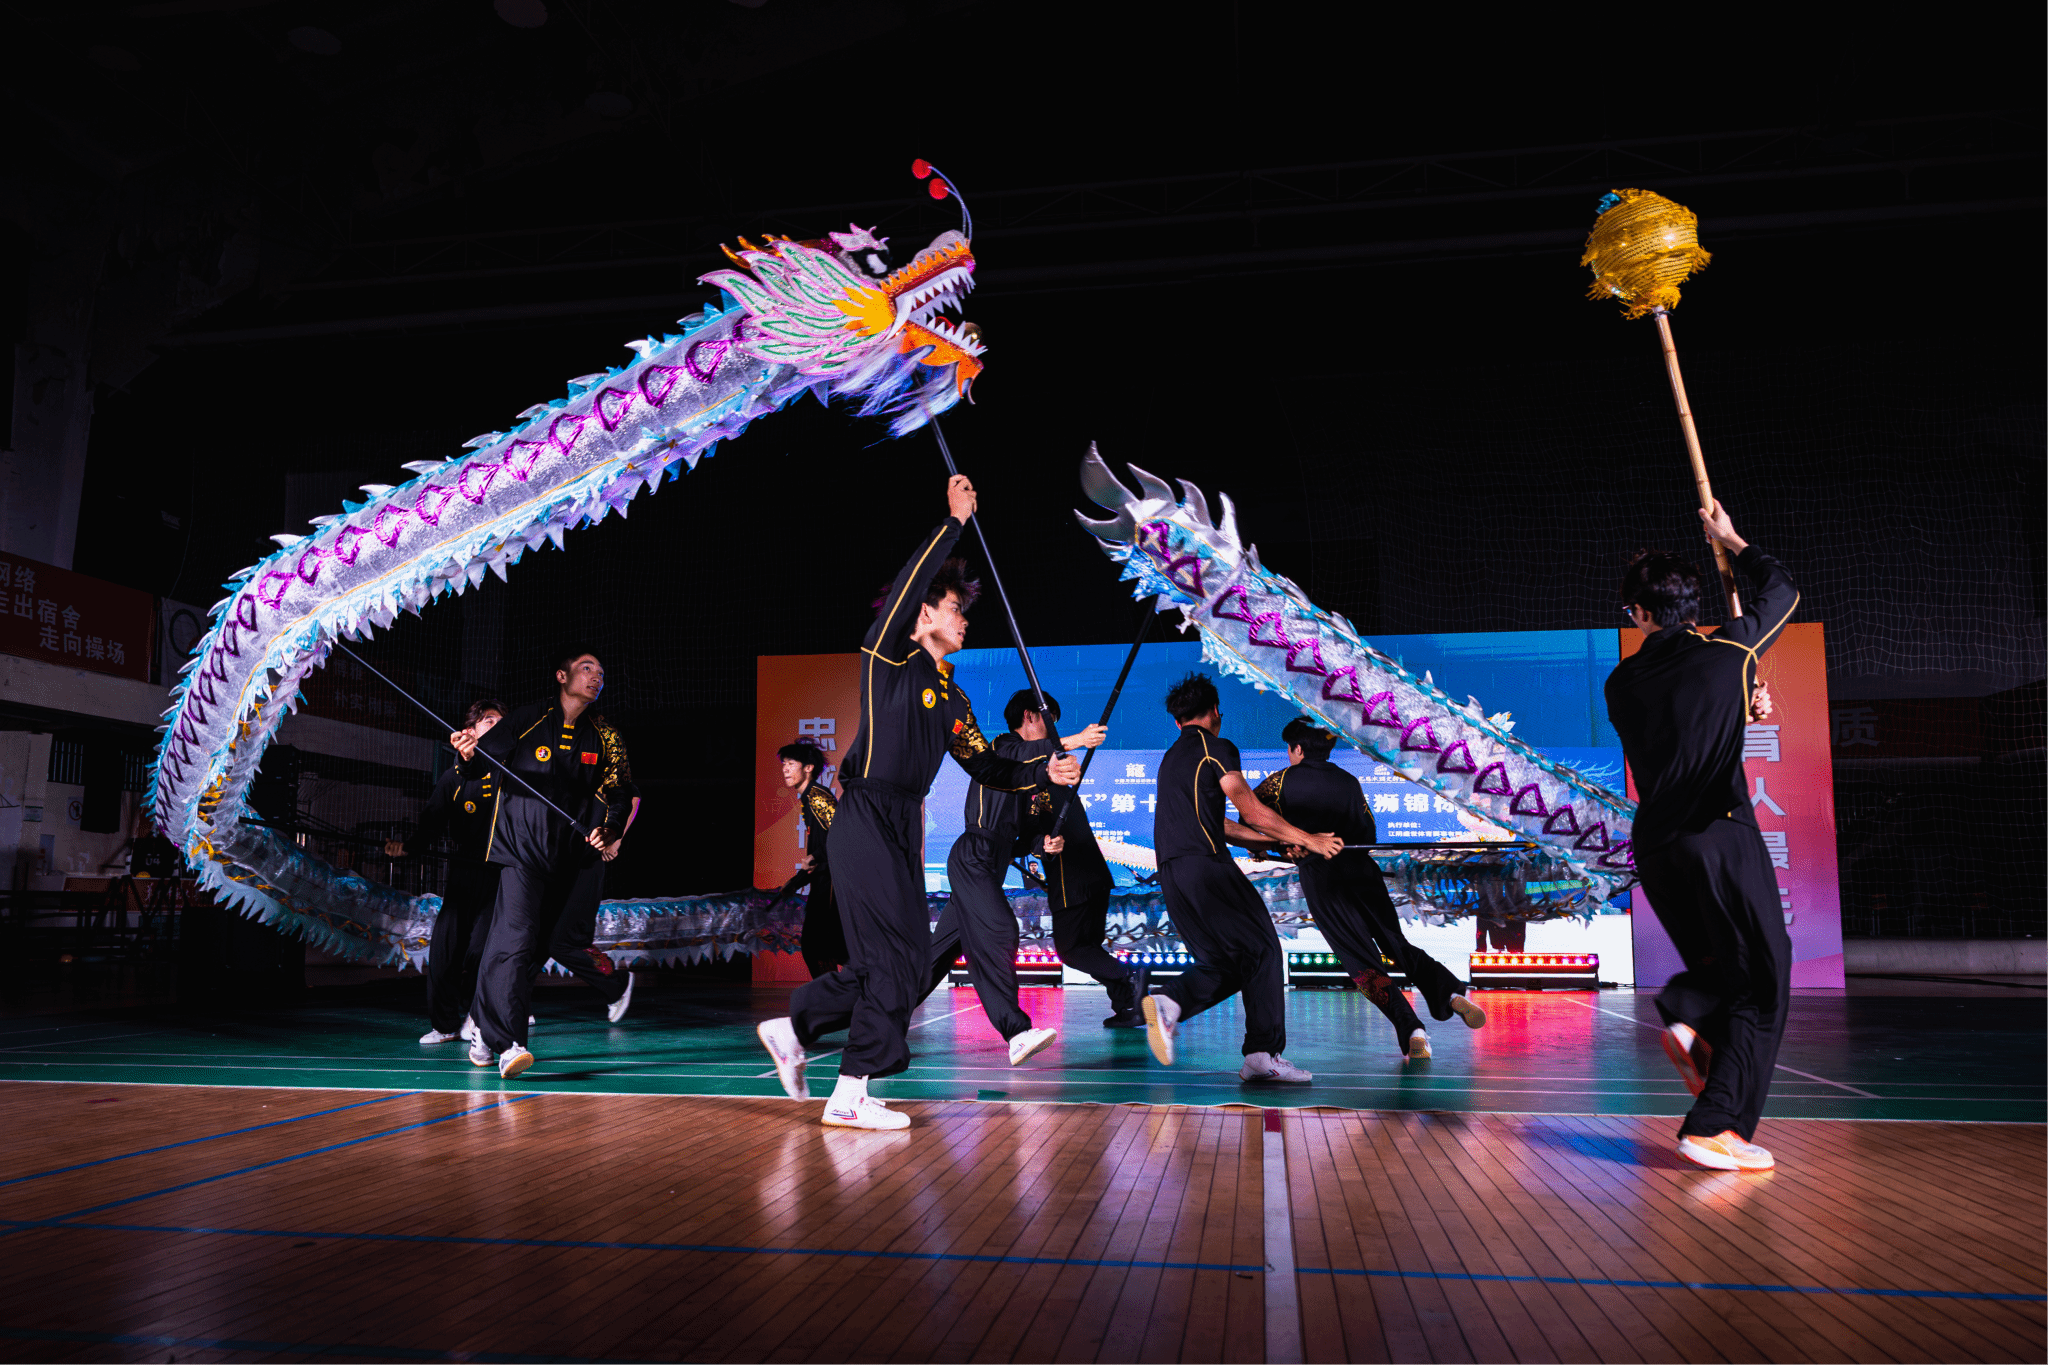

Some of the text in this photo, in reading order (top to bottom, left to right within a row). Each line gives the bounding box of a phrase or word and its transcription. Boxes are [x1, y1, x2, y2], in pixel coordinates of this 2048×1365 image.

[39, 625, 125, 665] 走向操场
[1831, 706, 1881, 748] 质
